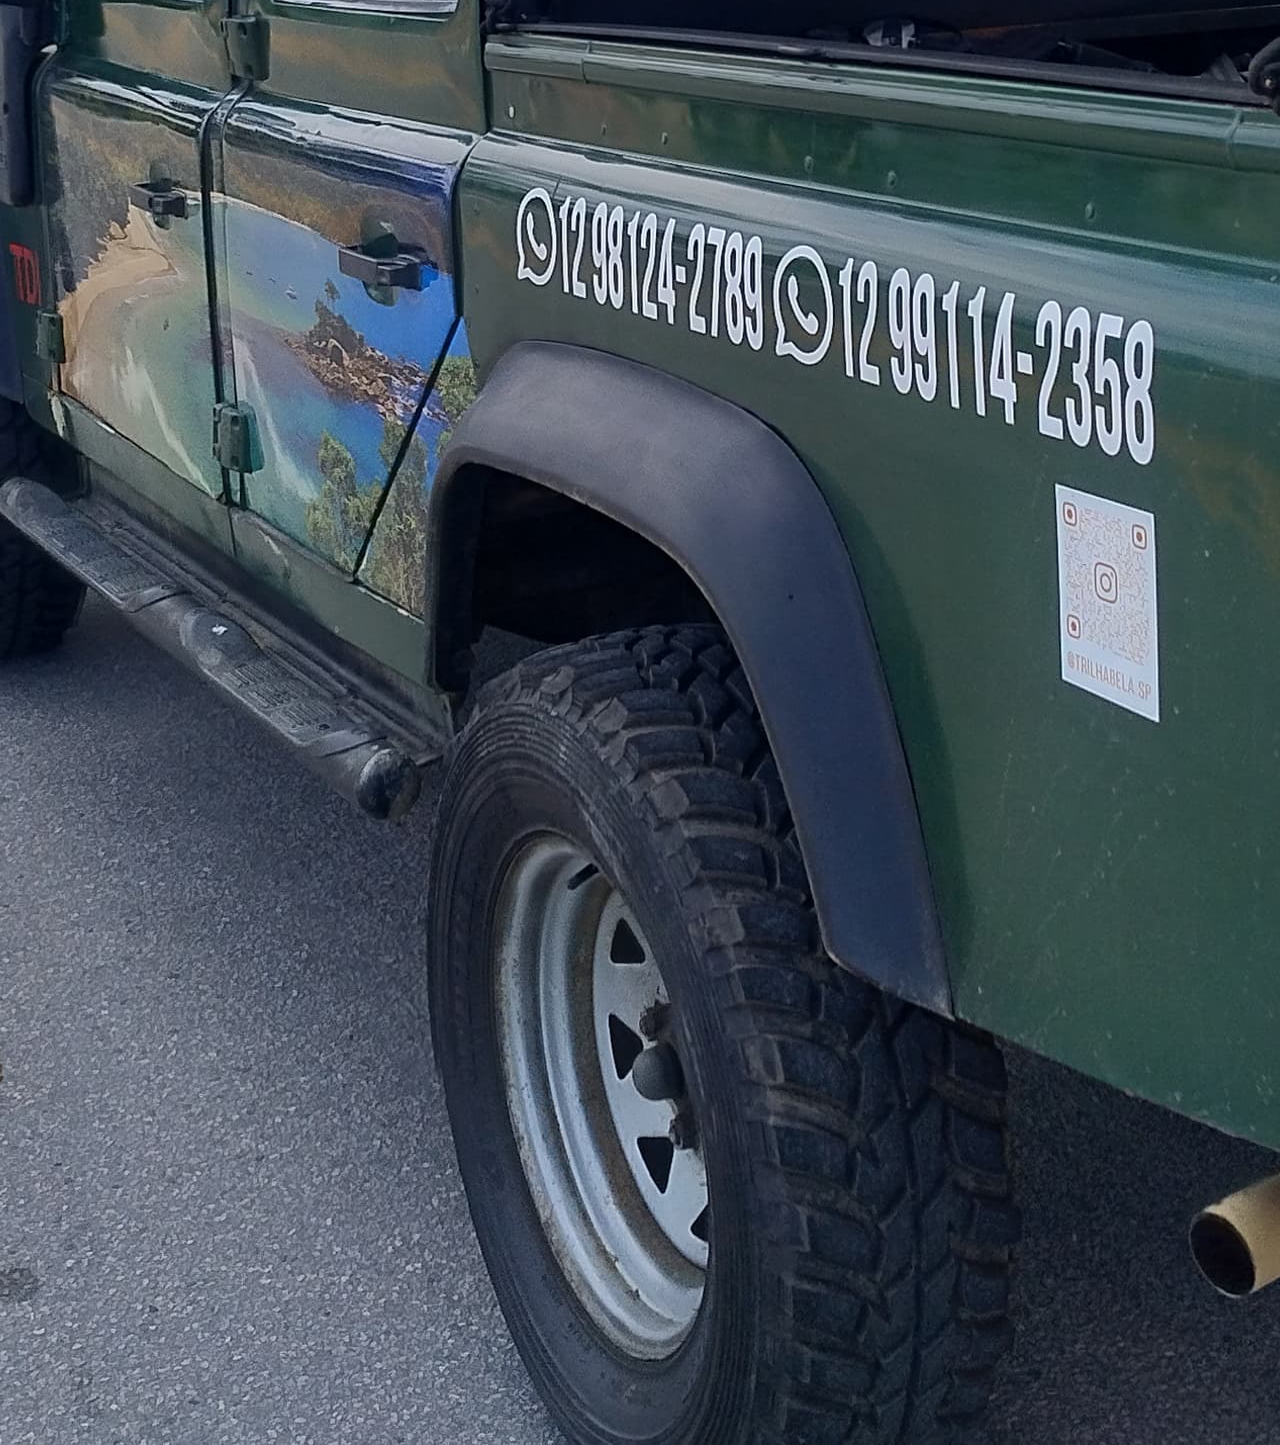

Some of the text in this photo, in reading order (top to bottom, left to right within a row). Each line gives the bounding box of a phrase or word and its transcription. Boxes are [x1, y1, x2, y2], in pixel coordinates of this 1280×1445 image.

[559, 195, 764, 351] 12 98124-2789
[838, 257, 1156, 466] 12 99114-2358
